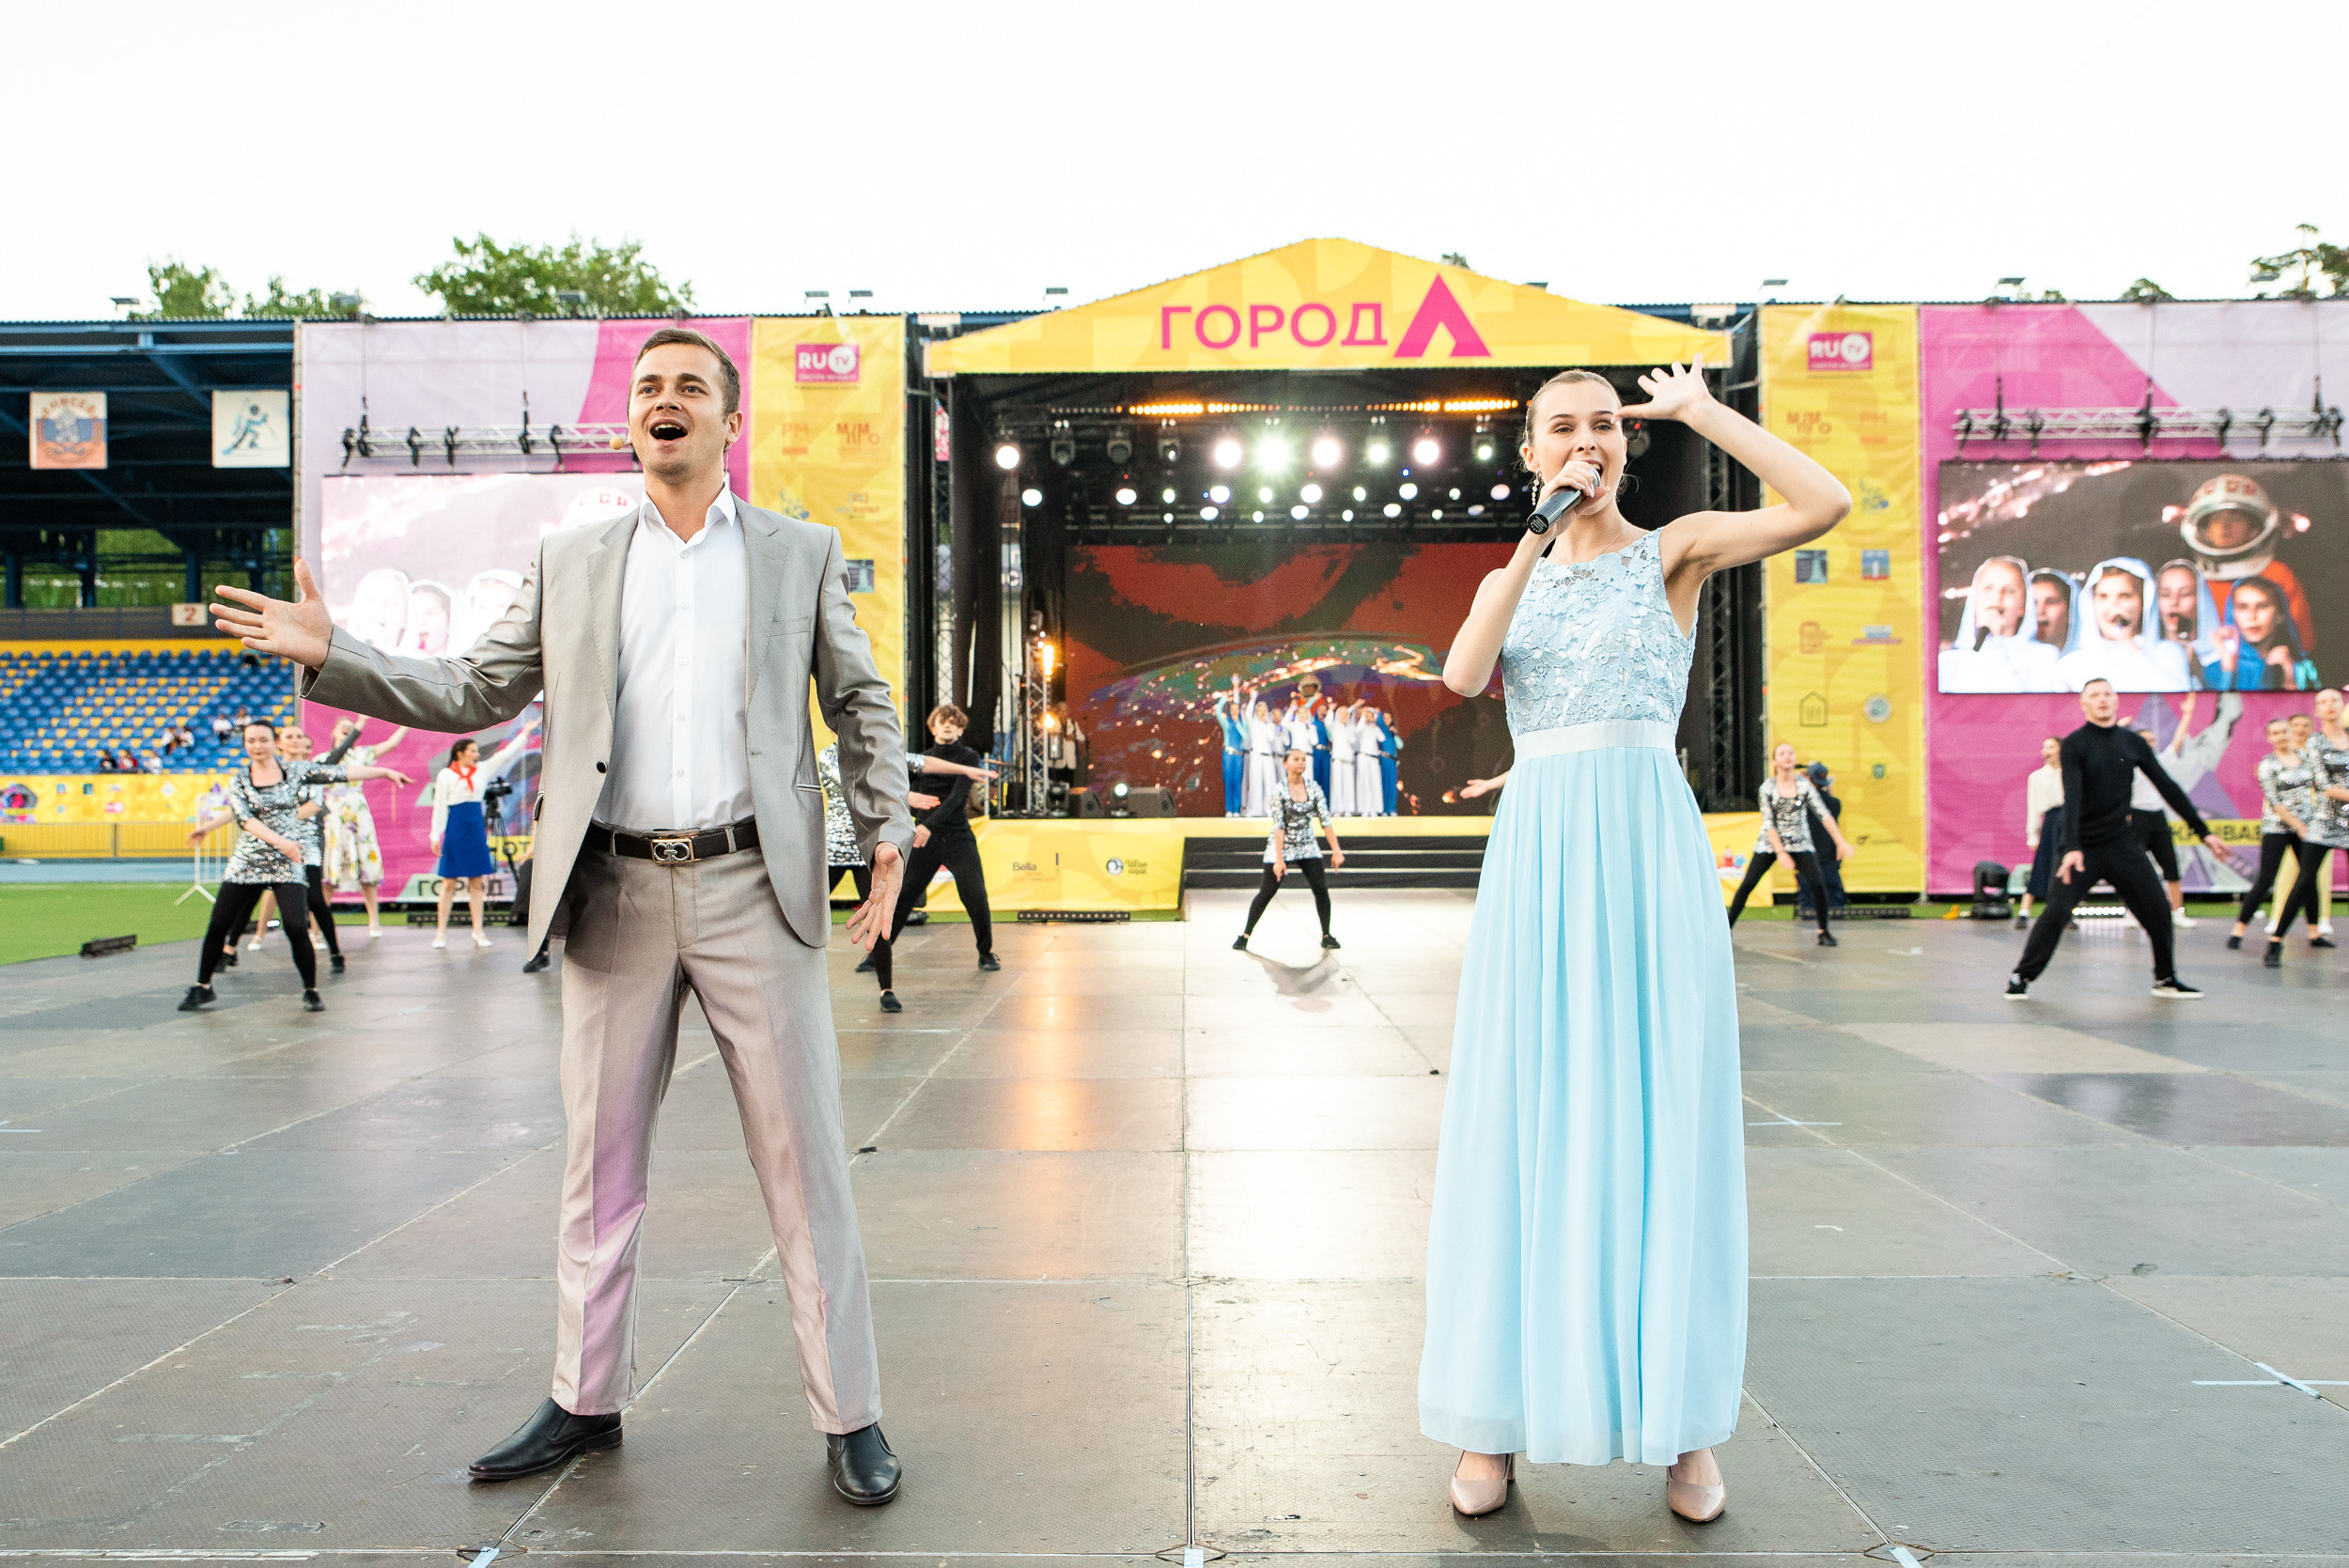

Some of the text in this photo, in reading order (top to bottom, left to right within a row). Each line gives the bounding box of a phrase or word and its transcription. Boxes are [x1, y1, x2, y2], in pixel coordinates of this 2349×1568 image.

[1161, 303, 1388, 349] ГОРОД
[1810, 340, 1840, 358] RU
[798, 352, 827, 369] RU
[1012, 862, 1037, 871] Bella
[418, 878, 504, 896] ГОРД
